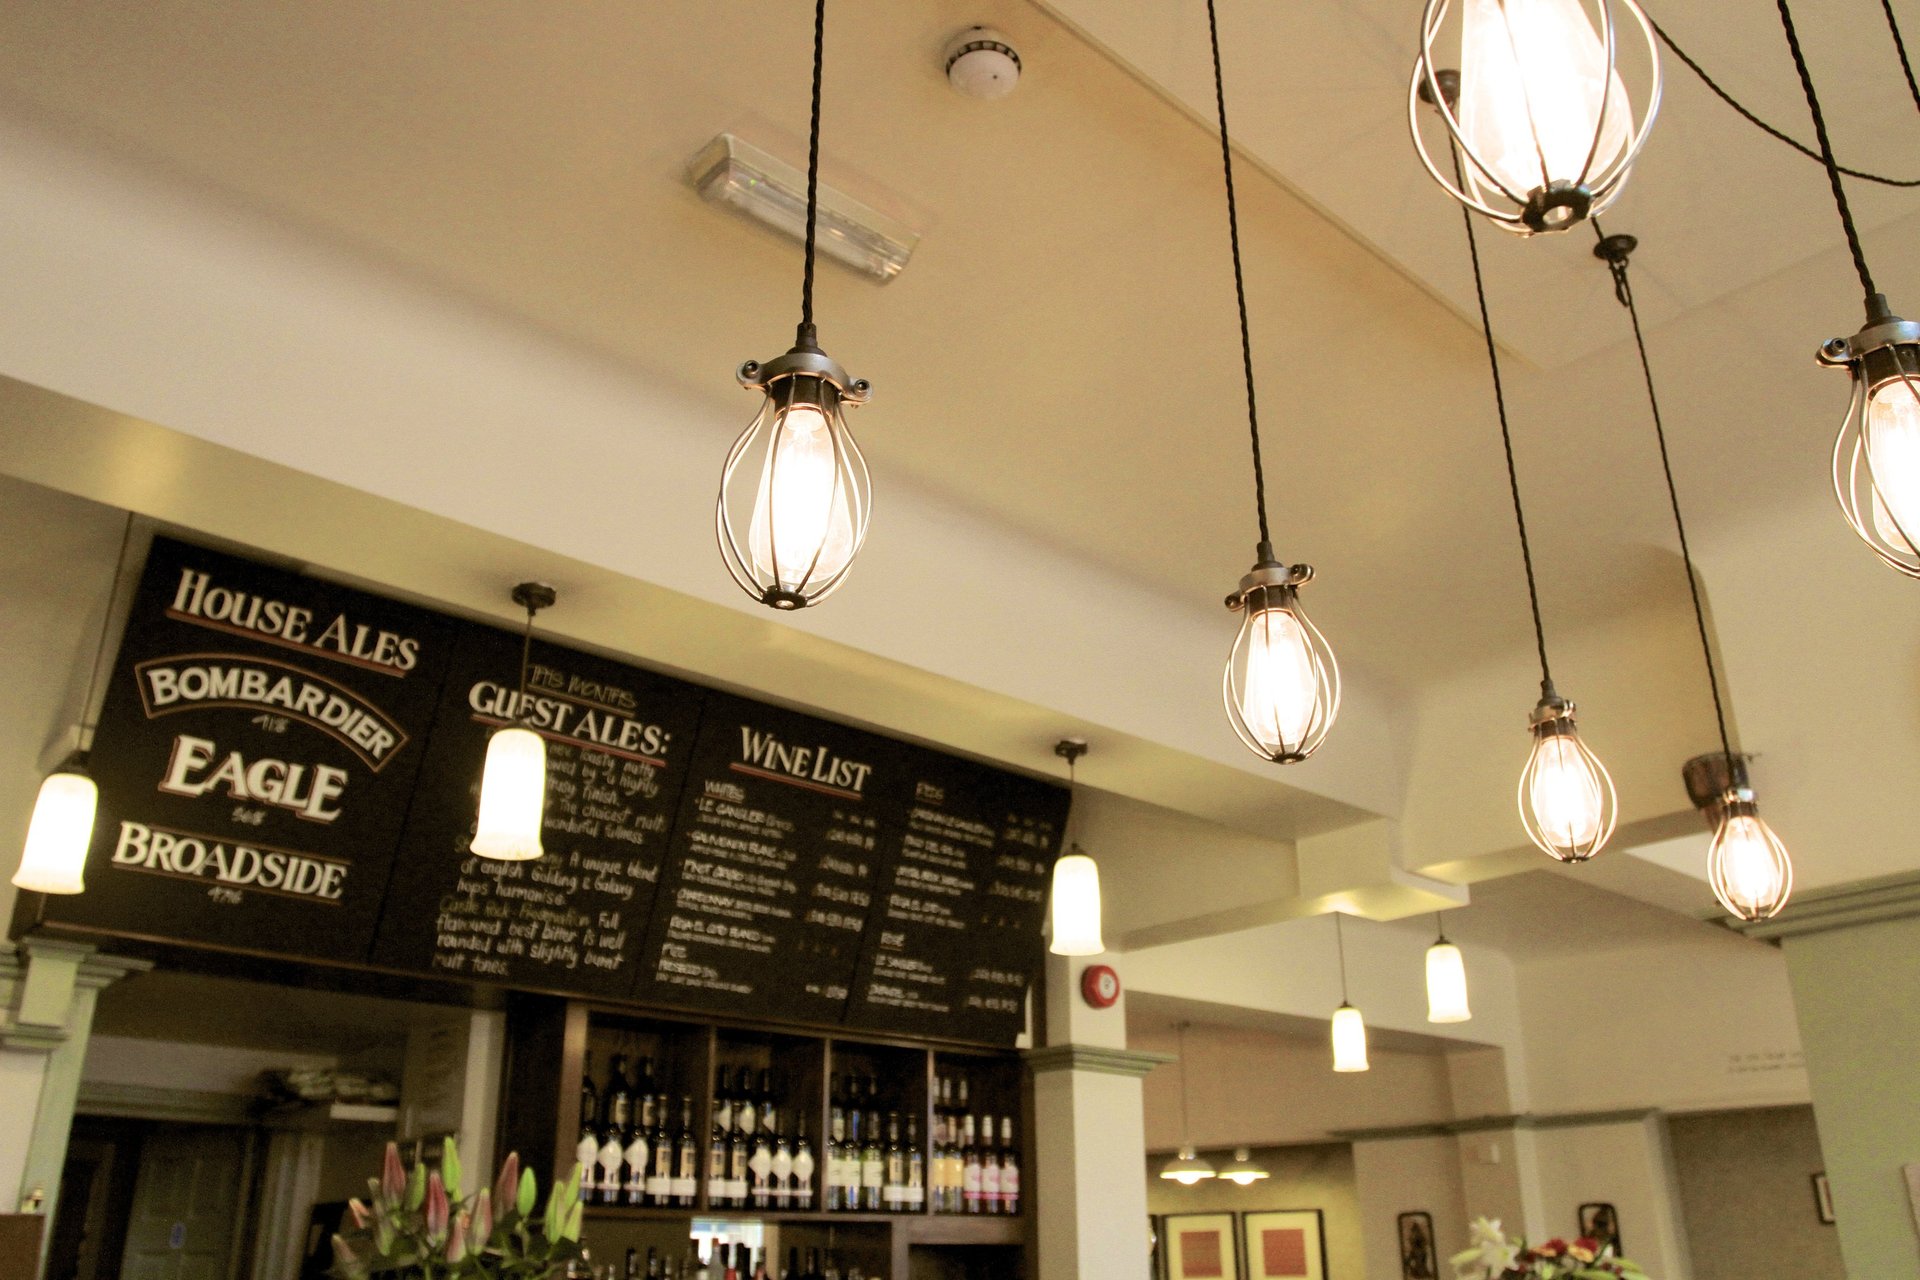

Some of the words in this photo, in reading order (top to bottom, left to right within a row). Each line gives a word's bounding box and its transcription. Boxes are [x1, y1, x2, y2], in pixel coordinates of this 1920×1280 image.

[170, 567, 313, 643] HOUSE
[315, 612, 420, 672] ALES
[146, 665, 396, 760] BOMBARDIER
[468, 680, 574, 732] GUEST
[159, 734, 348, 824] EAGLE
[740, 725, 813, 778] WINE
[811, 745, 873, 793] LIST
[112, 821, 348, 900] BROADSIDE
